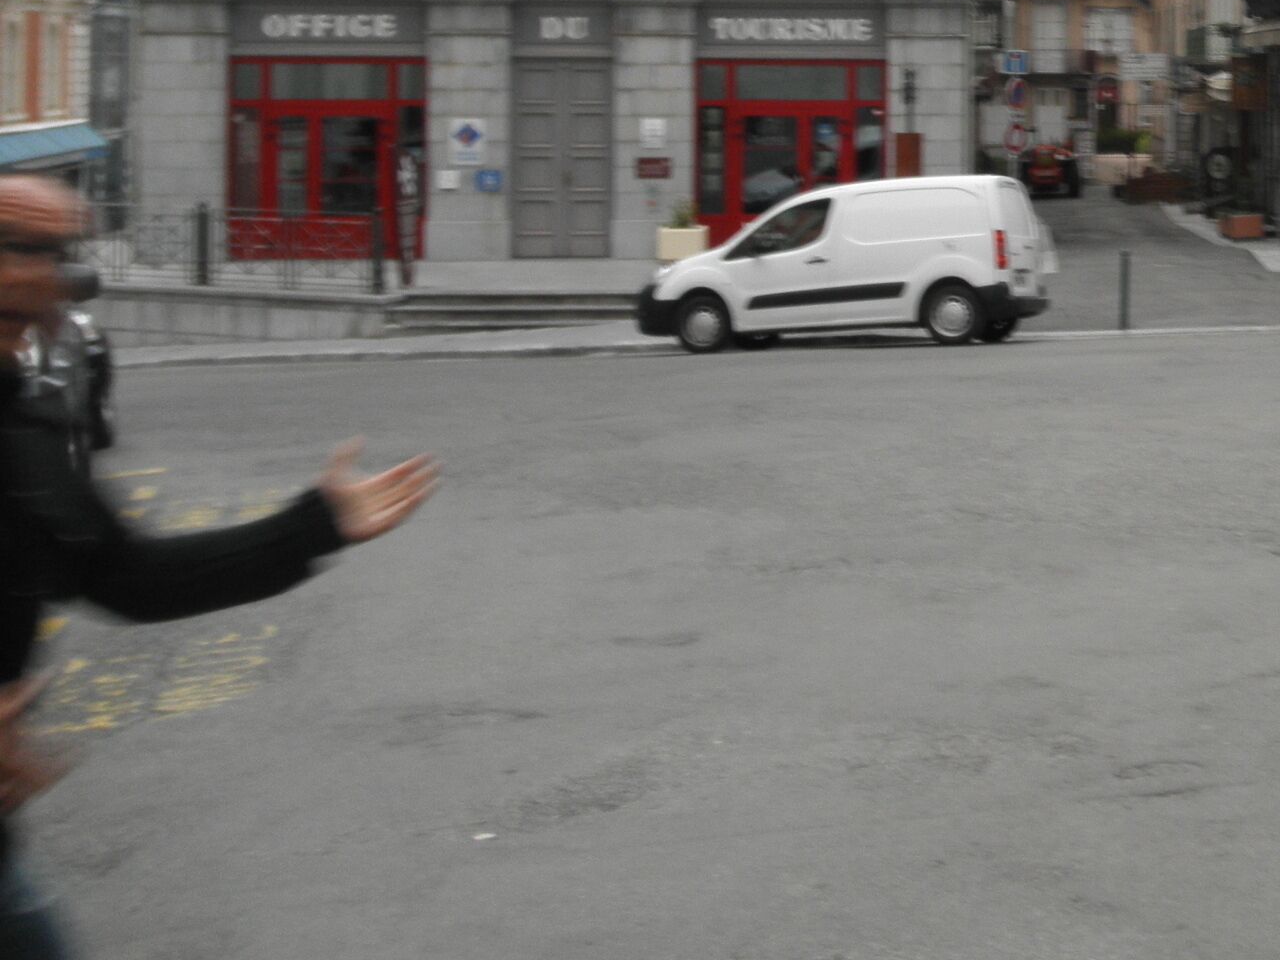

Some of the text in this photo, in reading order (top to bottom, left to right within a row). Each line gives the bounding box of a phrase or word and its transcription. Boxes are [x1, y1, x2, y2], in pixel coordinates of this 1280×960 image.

[260, 14, 874, 41] OFFICE DU TOURISME
